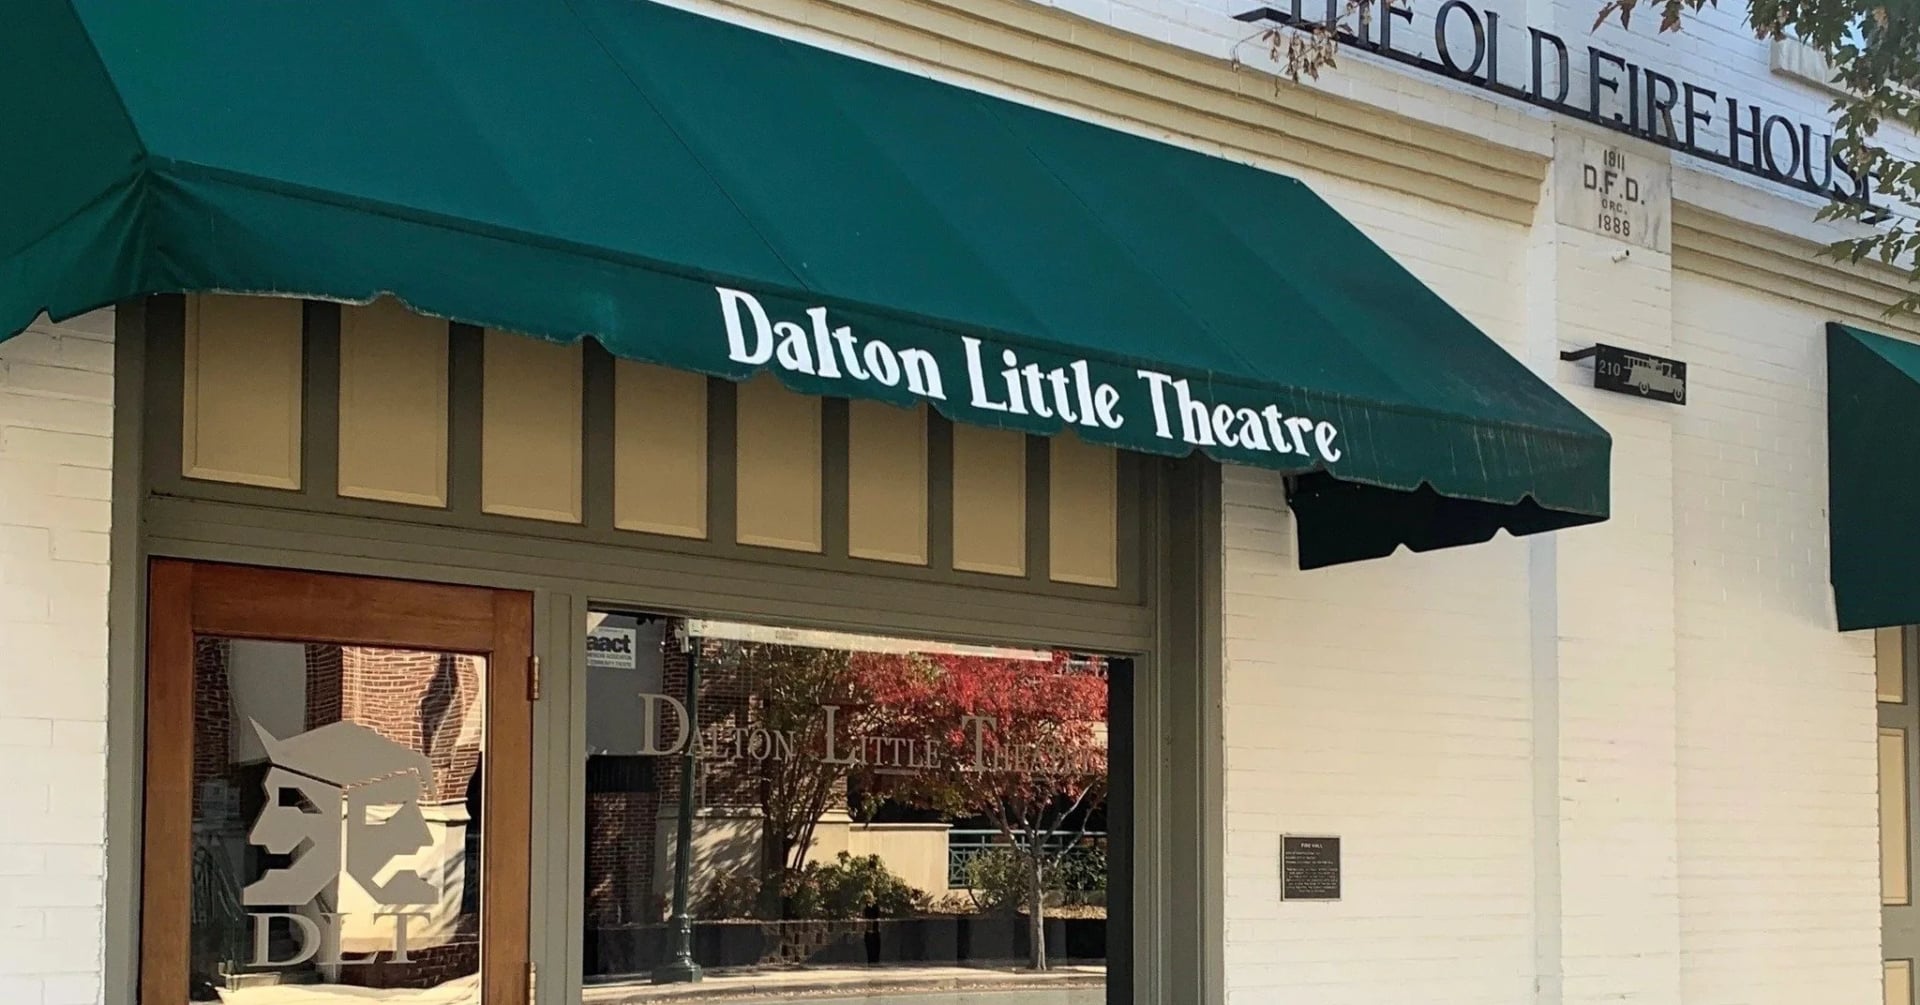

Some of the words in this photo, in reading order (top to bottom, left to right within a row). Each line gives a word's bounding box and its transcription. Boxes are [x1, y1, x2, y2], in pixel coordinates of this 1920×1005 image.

[1434, 0, 1568, 104] OLD
[1587, 46, 1719, 153] FIRE
[1584, 164, 1645, 206] D.F.D.
[1598, 213, 1631, 237] 1888
[715, 286, 946, 400] Dalton
[961, 336, 1124, 429] Little
[1137, 369, 1342, 463] Theatre
[1598, 359, 1621, 376] 210
[586, 635, 631, 653] aact
[637, 693, 798, 761] DALTON
[821, 705, 942, 769] LITTLE
[244, 912, 432, 968] DLT
